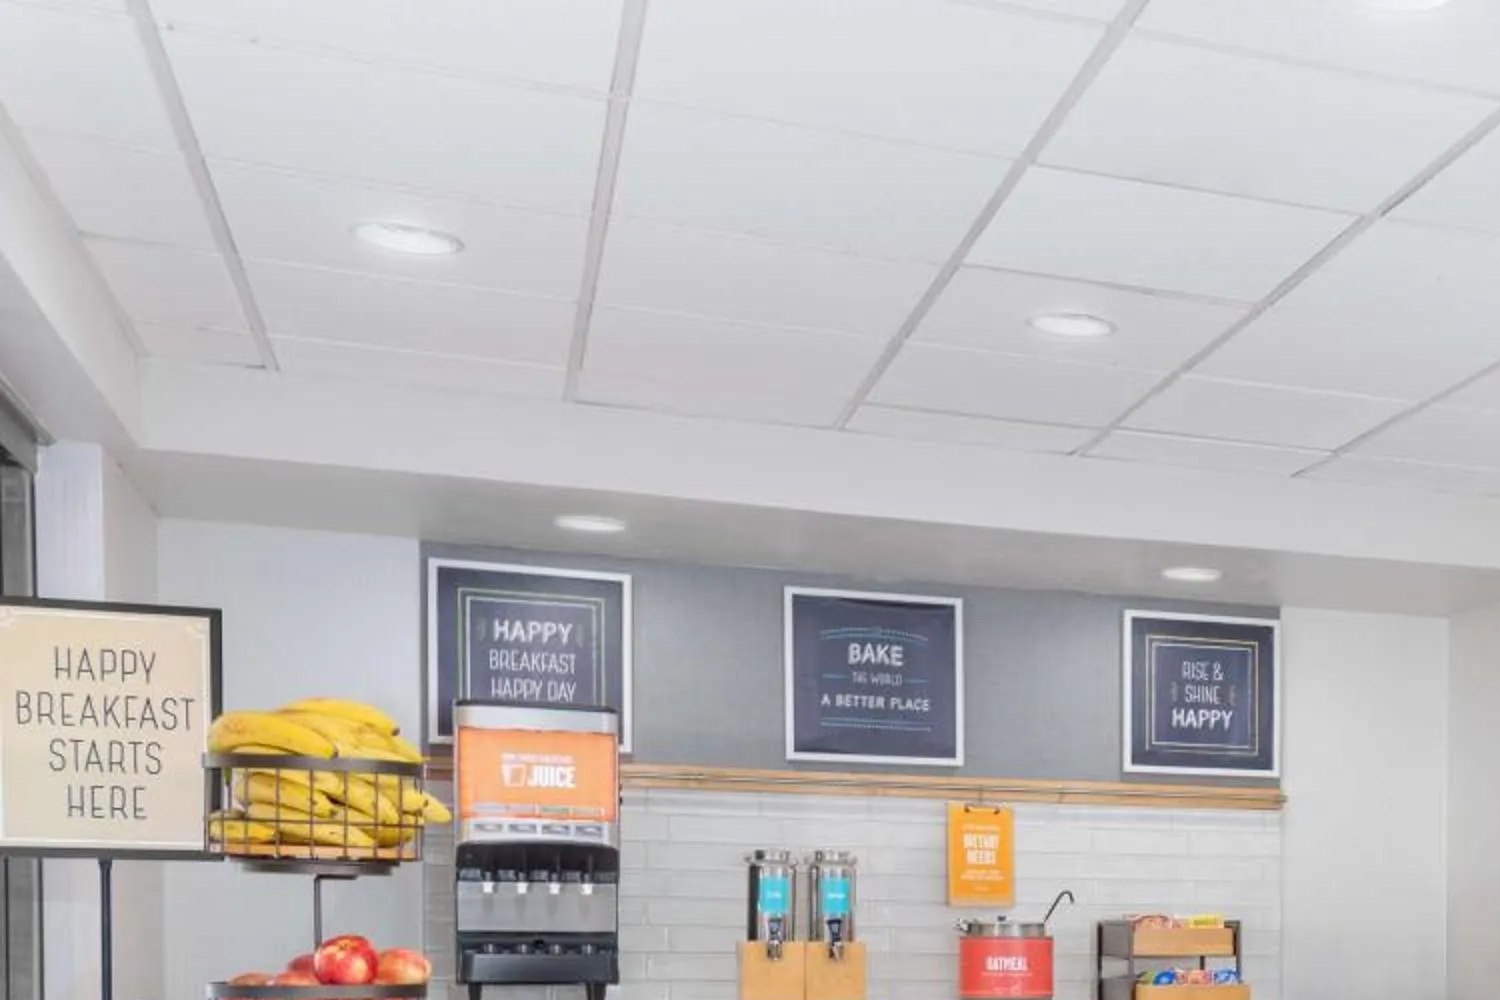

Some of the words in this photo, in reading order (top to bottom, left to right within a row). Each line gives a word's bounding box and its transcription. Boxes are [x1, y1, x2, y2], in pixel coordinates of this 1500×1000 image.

[493, 618, 573, 645] HAPPY
[53, 645, 157, 683] HAPPY
[489, 648, 576, 674] BREAKFAST
[847, 642, 904, 667] BAKE
[1181, 661, 1209, 680] RISE
[1212, 662, 1224, 680] &
[491, 677, 543, 701] HAPPY
[547, 680, 577, 702] DAY
[1184, 684, 1220, 704] SHINE
[15, 689, 196, 731] BREAKFAST
[821, 693, 831, 707] A
[835, 694, 885, 709] BETTER
[890, 697, 930, 712] PLACE
[1171, 708, 1233, 730] HAPPY
[48, 737, 162, 775] STARTS
[527, 764, 577, 789] JUICE
[66, 783, 147, 820] HERE
